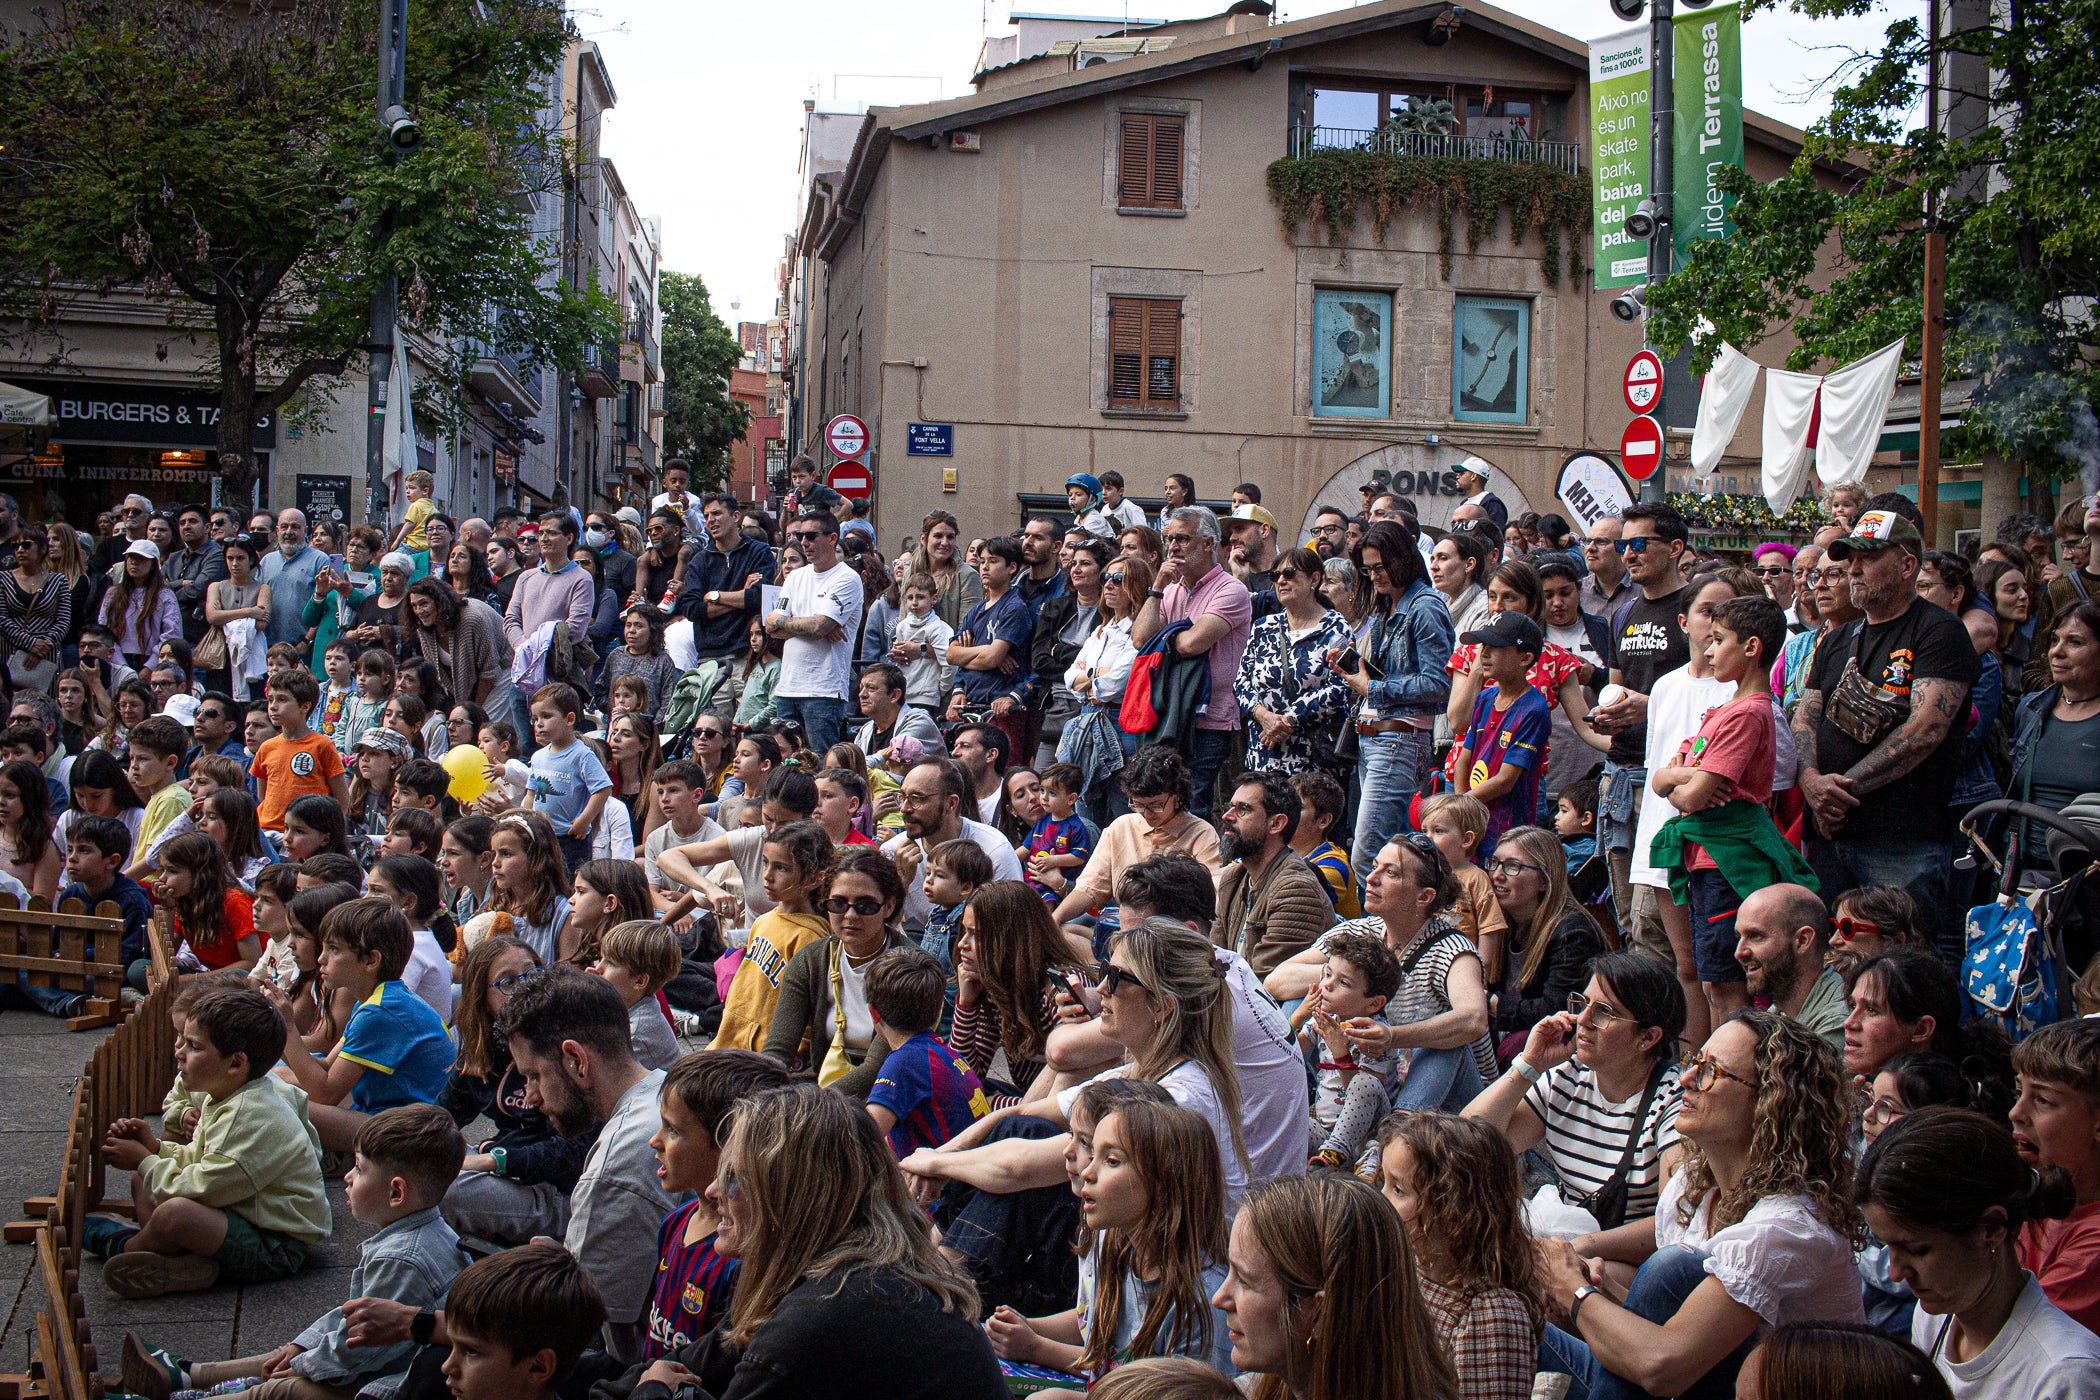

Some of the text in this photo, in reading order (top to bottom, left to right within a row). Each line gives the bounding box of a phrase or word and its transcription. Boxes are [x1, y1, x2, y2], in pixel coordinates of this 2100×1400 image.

[1600, 46, 1642, 64] Sancions de
[1600, 64, 1613, 74] fins
[1620, 57, 1638, 69] 1000
[1597, 89, 1648, 113] Això no
[1598, 115, 1636, 135] és un
[1700, 21, 1725, 240] uidem Terrassa
[1599, 136, 1638, 157] skate
[1599, 159, 1636, 183] park,
[1600, 182, 1643, 202] baixa
[1600, 204, 1626, 225] del
[60, 400, 170, 423] BURGERS
[176, 406, 192, 424] &
[11, 464, 66, 479] CUINA
[1695, 537, 1749, 549] NATUR
[1276, 1041, 1292, 1056] SINCE
